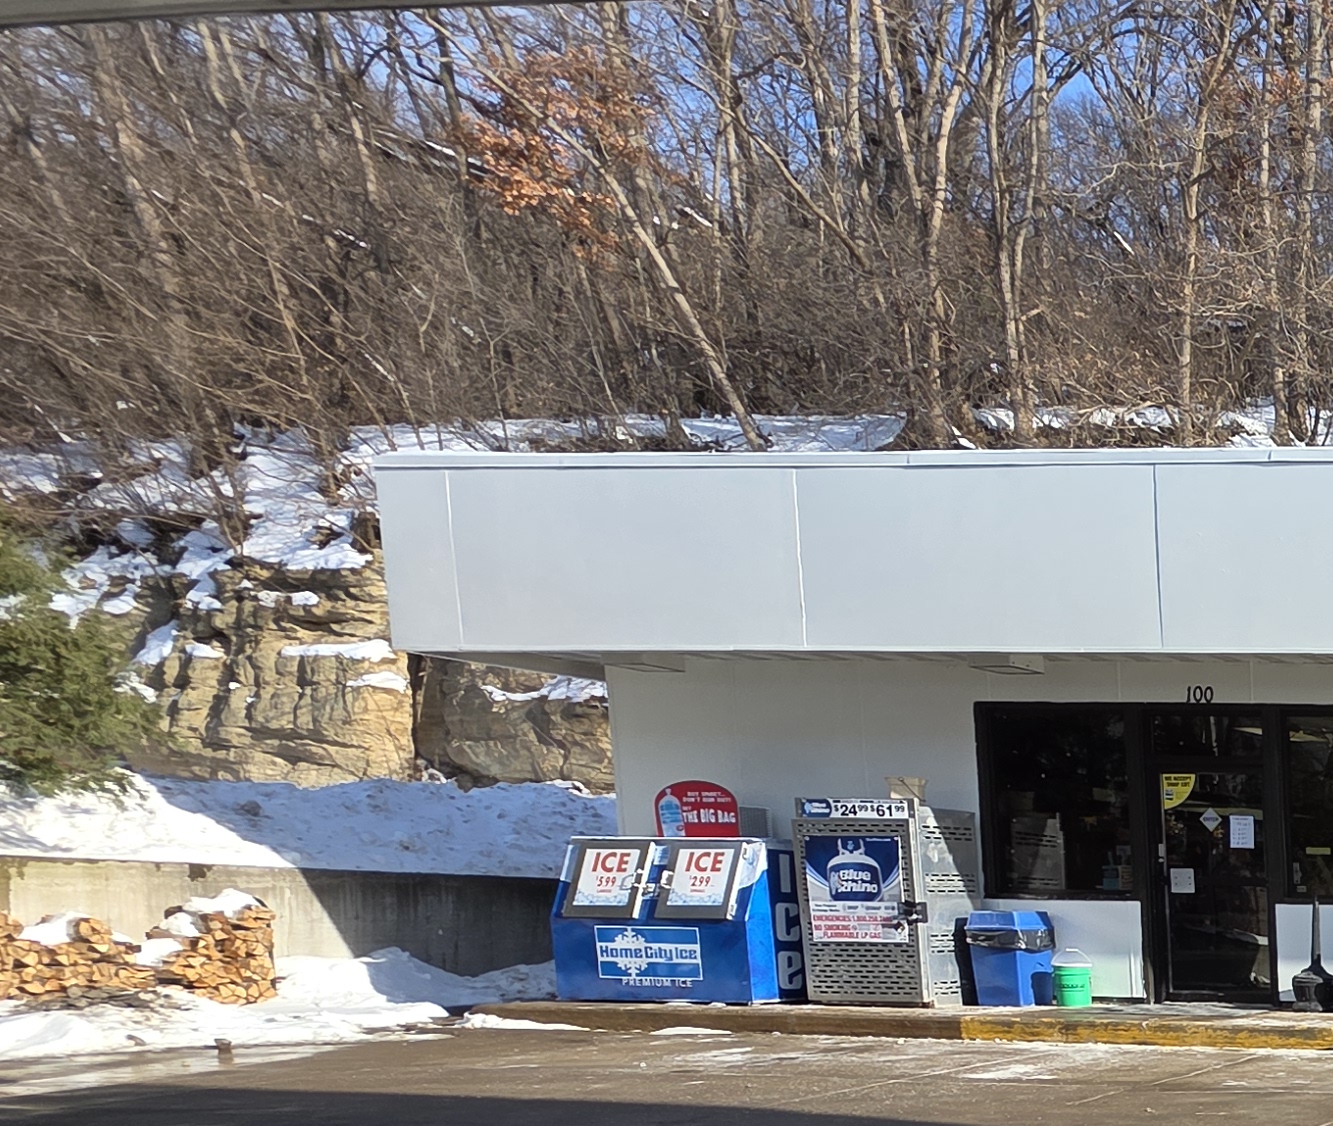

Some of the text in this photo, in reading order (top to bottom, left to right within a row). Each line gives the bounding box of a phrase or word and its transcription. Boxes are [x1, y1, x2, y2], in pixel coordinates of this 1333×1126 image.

[1186, 685, 1214, 703] 100
[683, 808, 736, 823] THE BIG BAG
[591, 852, 631, 873] ICE
[685, 852, 725, 873] ICE
[840, 869, 871, 881] Blue
[600, 945, 697, 962] Home City Ice
[622, 978, 693, 988] PREMIUM ICE
